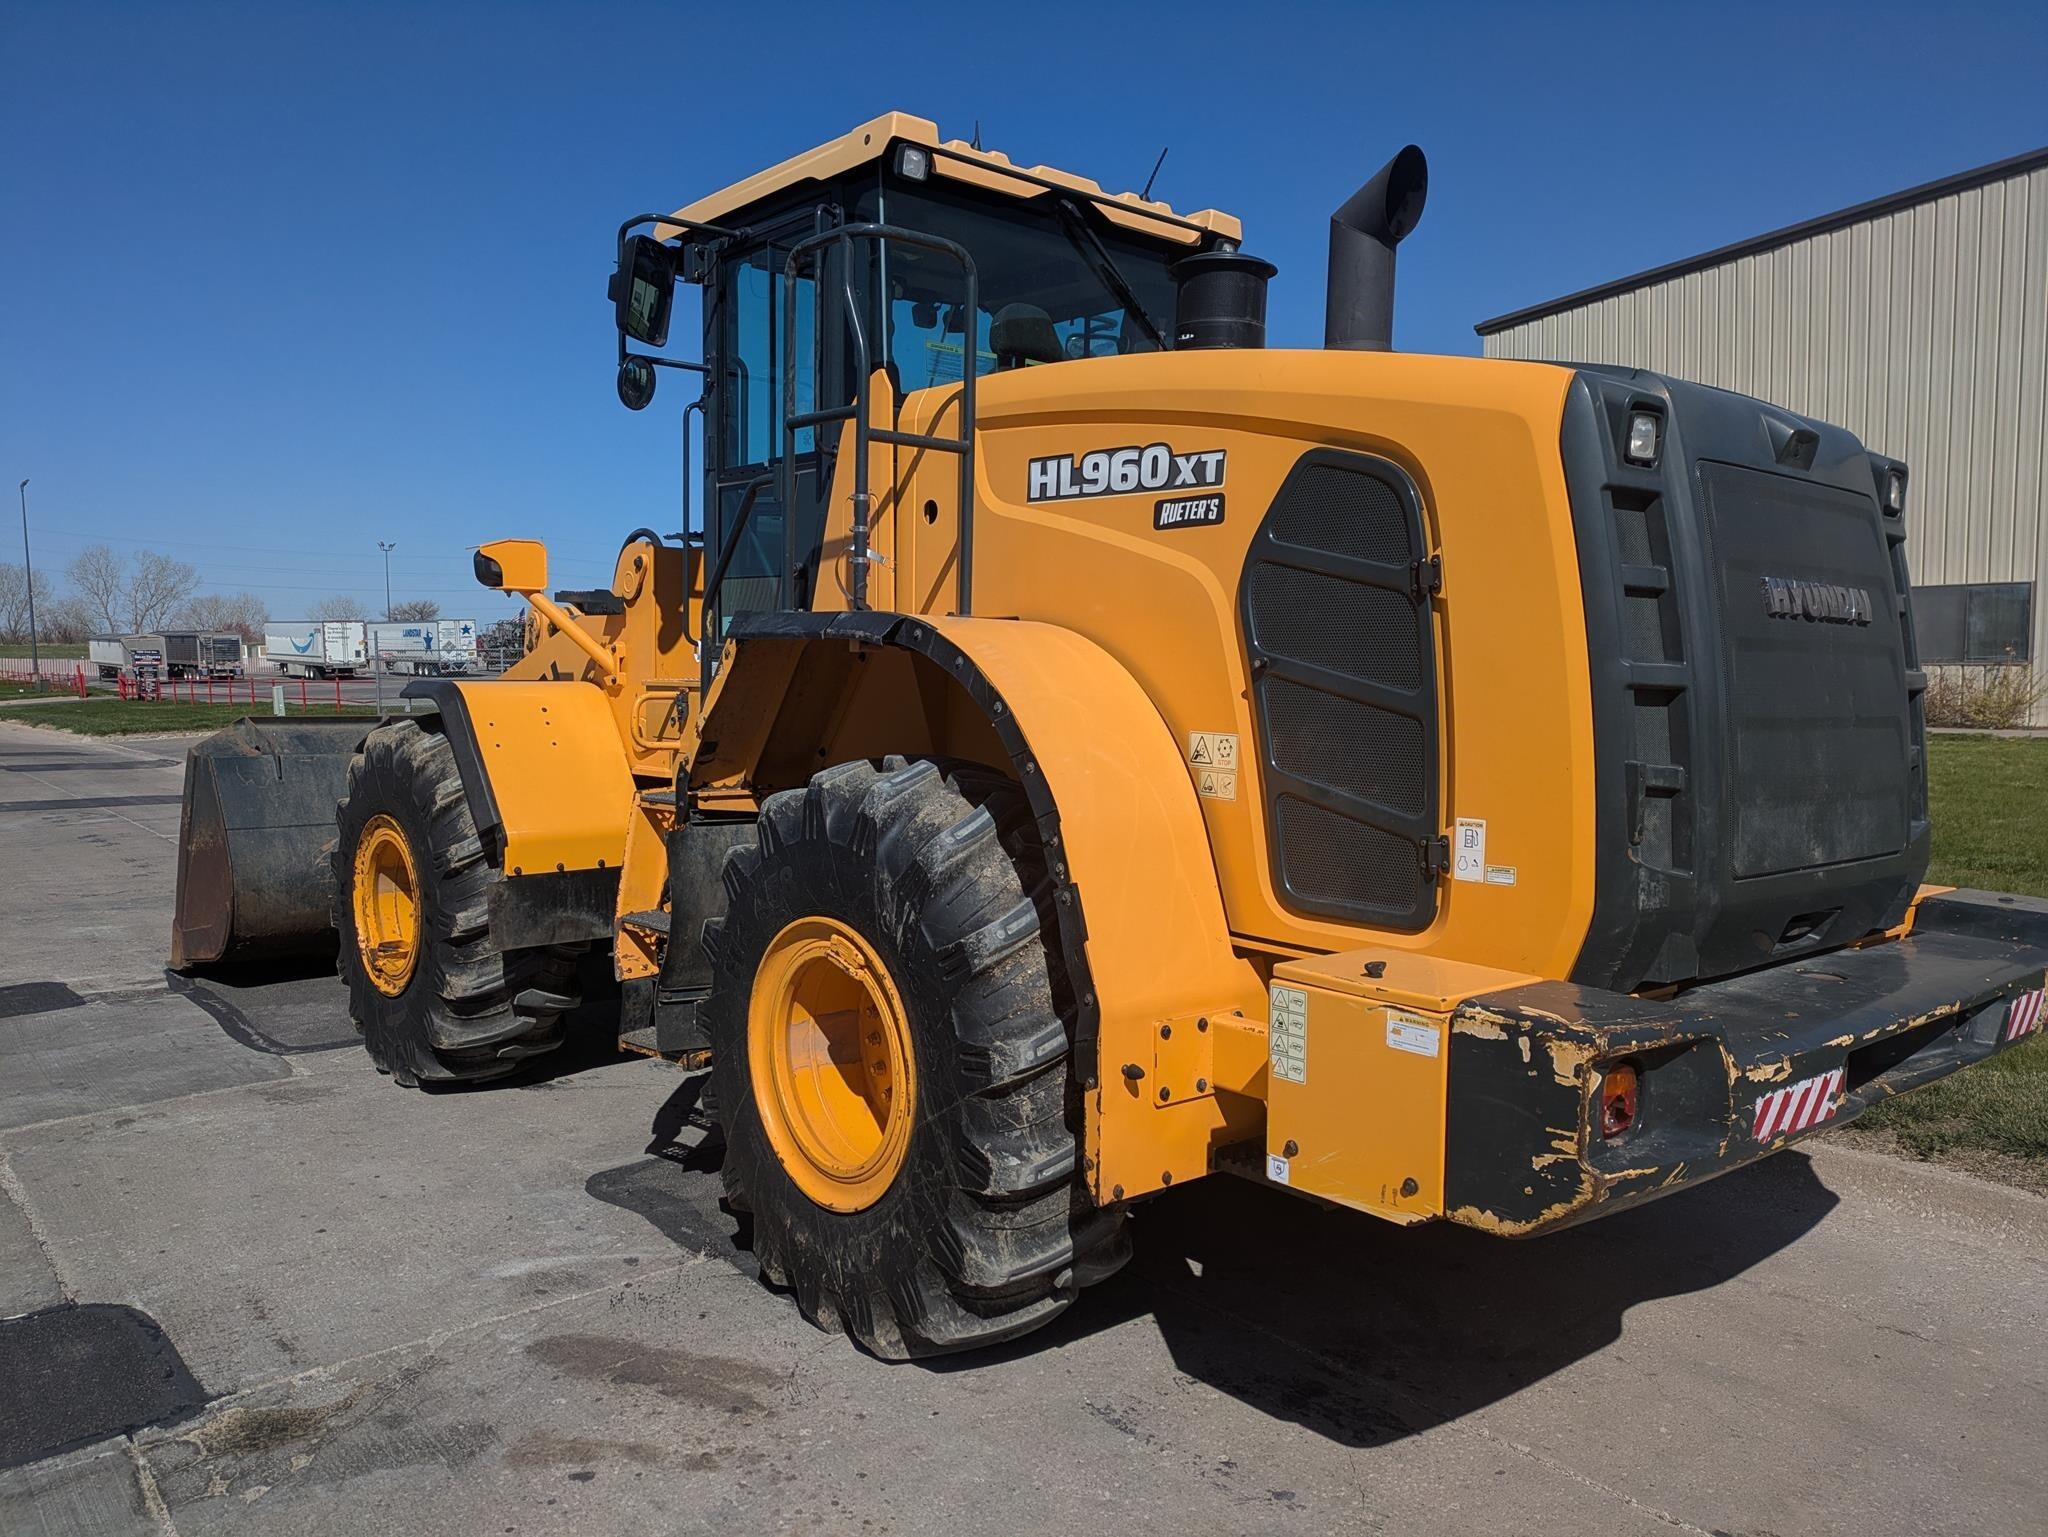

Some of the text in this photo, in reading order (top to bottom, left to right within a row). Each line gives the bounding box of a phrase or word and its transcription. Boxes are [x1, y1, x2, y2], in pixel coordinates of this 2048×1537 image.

[1159, 498, 1220, 526] RUETER'S
[1763, 576, 1872, 622] HYUNDAI
[1403, 1016, 1430, 1027] WARNING
